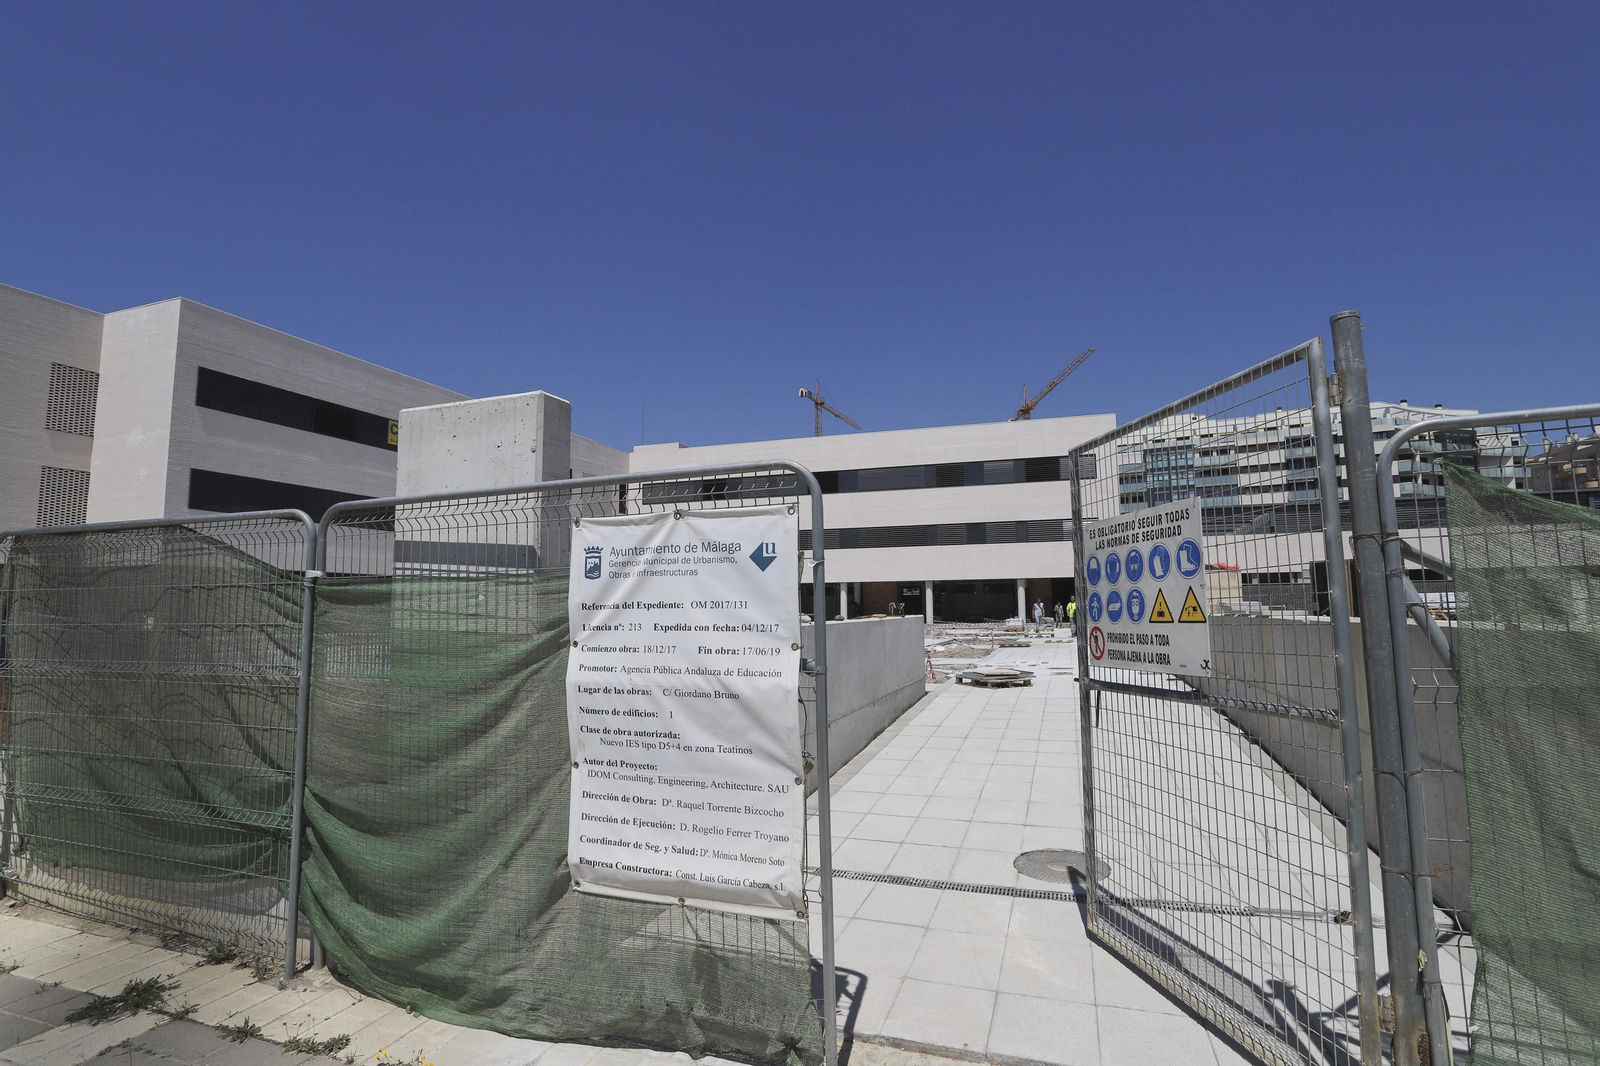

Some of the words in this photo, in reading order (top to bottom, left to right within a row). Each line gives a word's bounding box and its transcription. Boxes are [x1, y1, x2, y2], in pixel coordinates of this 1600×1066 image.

[1090, 530, 1096, 539] ES
[1098, 520, 1135, 538] OBLIGATORIO
[1138, 514, 1162, 529] SEGUIR
[1165, 508, 1190, 523] TODAS
[1095, 540, 1105, 550] LAS
[1107, 535, 1130, 548] NORMAS
[1132, 533, 1139, 543] DE
[1142, 525, 1182, 542] SEGURIDAD
[610, 544, 681, 557] Ayuntamiento
[684, 543, 698, 553] de
[702, 541, 741, 554] Málaga
[608, 558, 641, 568] Gerencia
[642, 556, 679, 567] Municipal
[681, 556, 692, 564] de
[609, 570, 631, 579] Obras
[637, 568, 698, 578] Infraestructuras
[622, 602, 635, 610] del
[637, 601, 684, 611] Expediente:
[691, 601, 707, 610] OM
[710, 601, 748, 610] 2017/131
[582, 624, 612, 632] Licencia
[653, 623, 692, 633] Expedida
[712, 624, 740, 632] fecha:
[741, 624, 779, 633] 04/12/17
[1107, 633, 1129, 644] PROHIBIDO
[1130, 634, 1135, 644] EL
[1136, 634, 1149, 645] PASO
[1150, 634, 1154, 645] A
[1155, 634, 1170, 646] TODA
[581, 645, 617, 653] Comienzo
[618, 645, 640, 653] obra:
[643, 645, 676, 654] 18/12/17
[698, 646, 712, 655] Fin
[715, 647, 740, 655] obra:
[743, 648, 781, 656] 17/06/19
[1108, 649, 1126, 661] PERSONA
[1143, 652, 1146, 663] A
[1148, 652, 1154, 664] LA
[1155, 653, 1171, 665] OBRA
[579, 664, 617, 673] Promotor:
[620, 666, 650, 676] Agencia
[653, 665, 682, 675] Pública
[684, 667, 721, 676] Andaluza
[724, 668, 734, 676] de
[737, 668, 781, 678] Educación
[578, 686, 601, 695] Lugar
[627, 687, 652, 696] obras:
[662, 689, 672, 697] C/
[674, 688, 711, 699] Giordano
[714, 690, 740, 700] Bruno
[579, 706, 610, 716] Número
[611, 708, 621, 716] de
[622, 709, 658, 718] edificios:
[580, 725, 601, 734] Clase
[613, 728, 632, 736] obra
[634, 729, 680, 740] autorizada:
[600, 738, 624, 747] Nuevo
[625, 740, 640, 748] IES
[642, 740, 657, 751] tipo
[658, 741, 681, 751] D5+4
[717, 745, 753, 754] Teatinos
[583, 757, 604, 767] Autor
[606, 759, 618, 768] del
[620, 760, 658, 771] Proyecto:
[587, 770, 611, 779] IDOM
[613, 773, 656, 784] Consulting,
[658, 776, 708, 789] Engineering,
[767, 784, 790, 794] SAU
[582, 791, 619, 802] Dirección
[621, 794, 630, 803] de
[632, 795, 656, 806] Obra:
[676, 800, 705, 812] Raquel
[707, 802, 741, 814] Torrente
[744, 806, 784, 818] Bizcocho
[581, 812, 618, 824] Dirección
[620, 817, 631, 826] de
[632, 817, 676, 830] Ejecución:
[680, 822, 689, 831] D.
[692, 824, 724, 836] Rogelio
[726, 828, 752, 839] Ferrer
[754, 830, 790, 842] Troyano
[580, 835, 631, 848] Coordinador
[633, 841, 643, 849] de
[645, 842, 662, 853] Seg.
[664, 846, 669, 855] y
[671, 845, 698, 856] Salud:
[712, 849, 738, 861] Mónica
[739, 852, 767, 864] Moreno
[768, 856, 785, 866] Soto
[579, 857, 613, 870] Empresa
[615, 861, 672, 877] Constructora:
[675, 870, 698, 882] Const.
[699, 872, 715, 883] Luis
[717, 874, 741, 887] García
[743, 878, 772, 890] Cabeza,
[774, 881, 786, 892] s.l.
